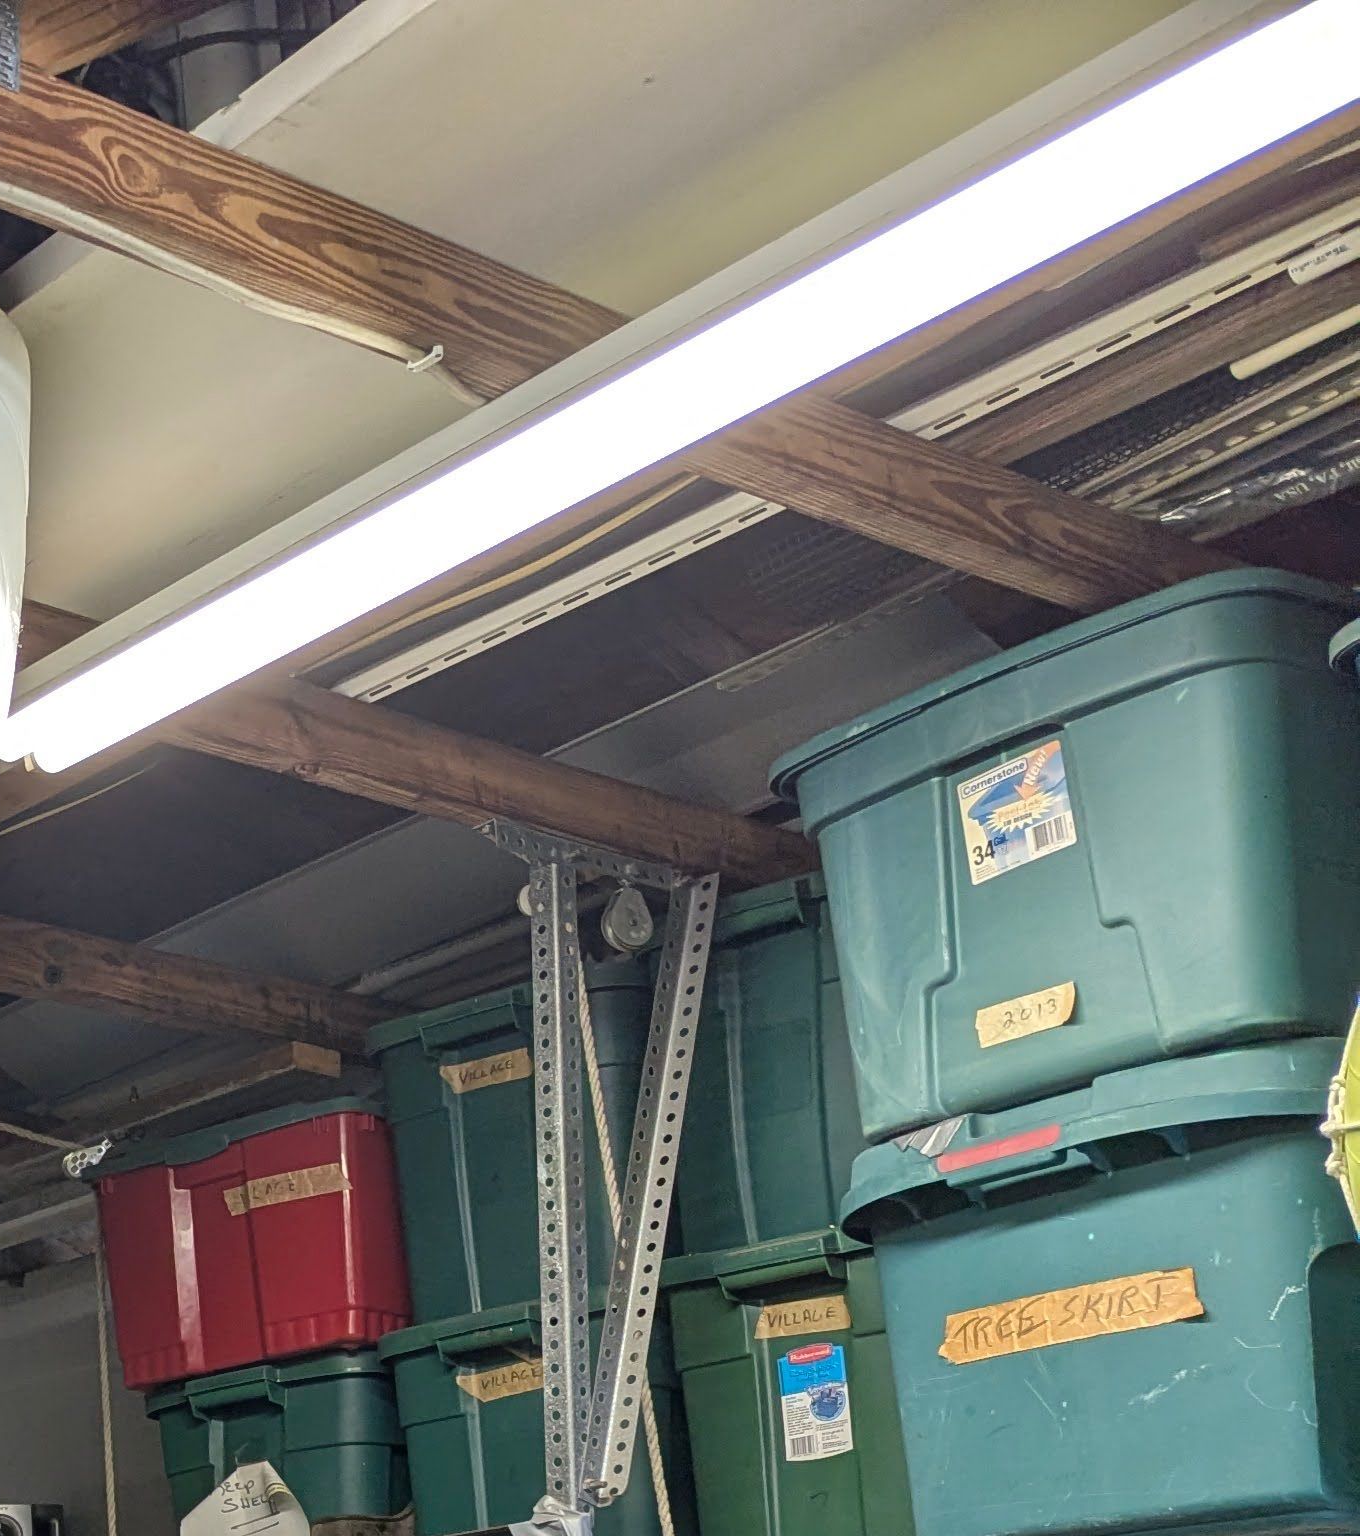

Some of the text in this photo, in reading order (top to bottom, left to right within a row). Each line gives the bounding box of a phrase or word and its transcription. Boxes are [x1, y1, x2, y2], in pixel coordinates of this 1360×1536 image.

[962, 761, 1025, 796] Cornerstone
[972, 840, 995, 866] 34
[1002, 998, 1058, 1029] 2013
[459, 1059, 512, 1085] VILLAGE
[954, 1275, 1180, 1354] TREE SKIRT
[481, 1365, 543, 1391] VILLAGE
